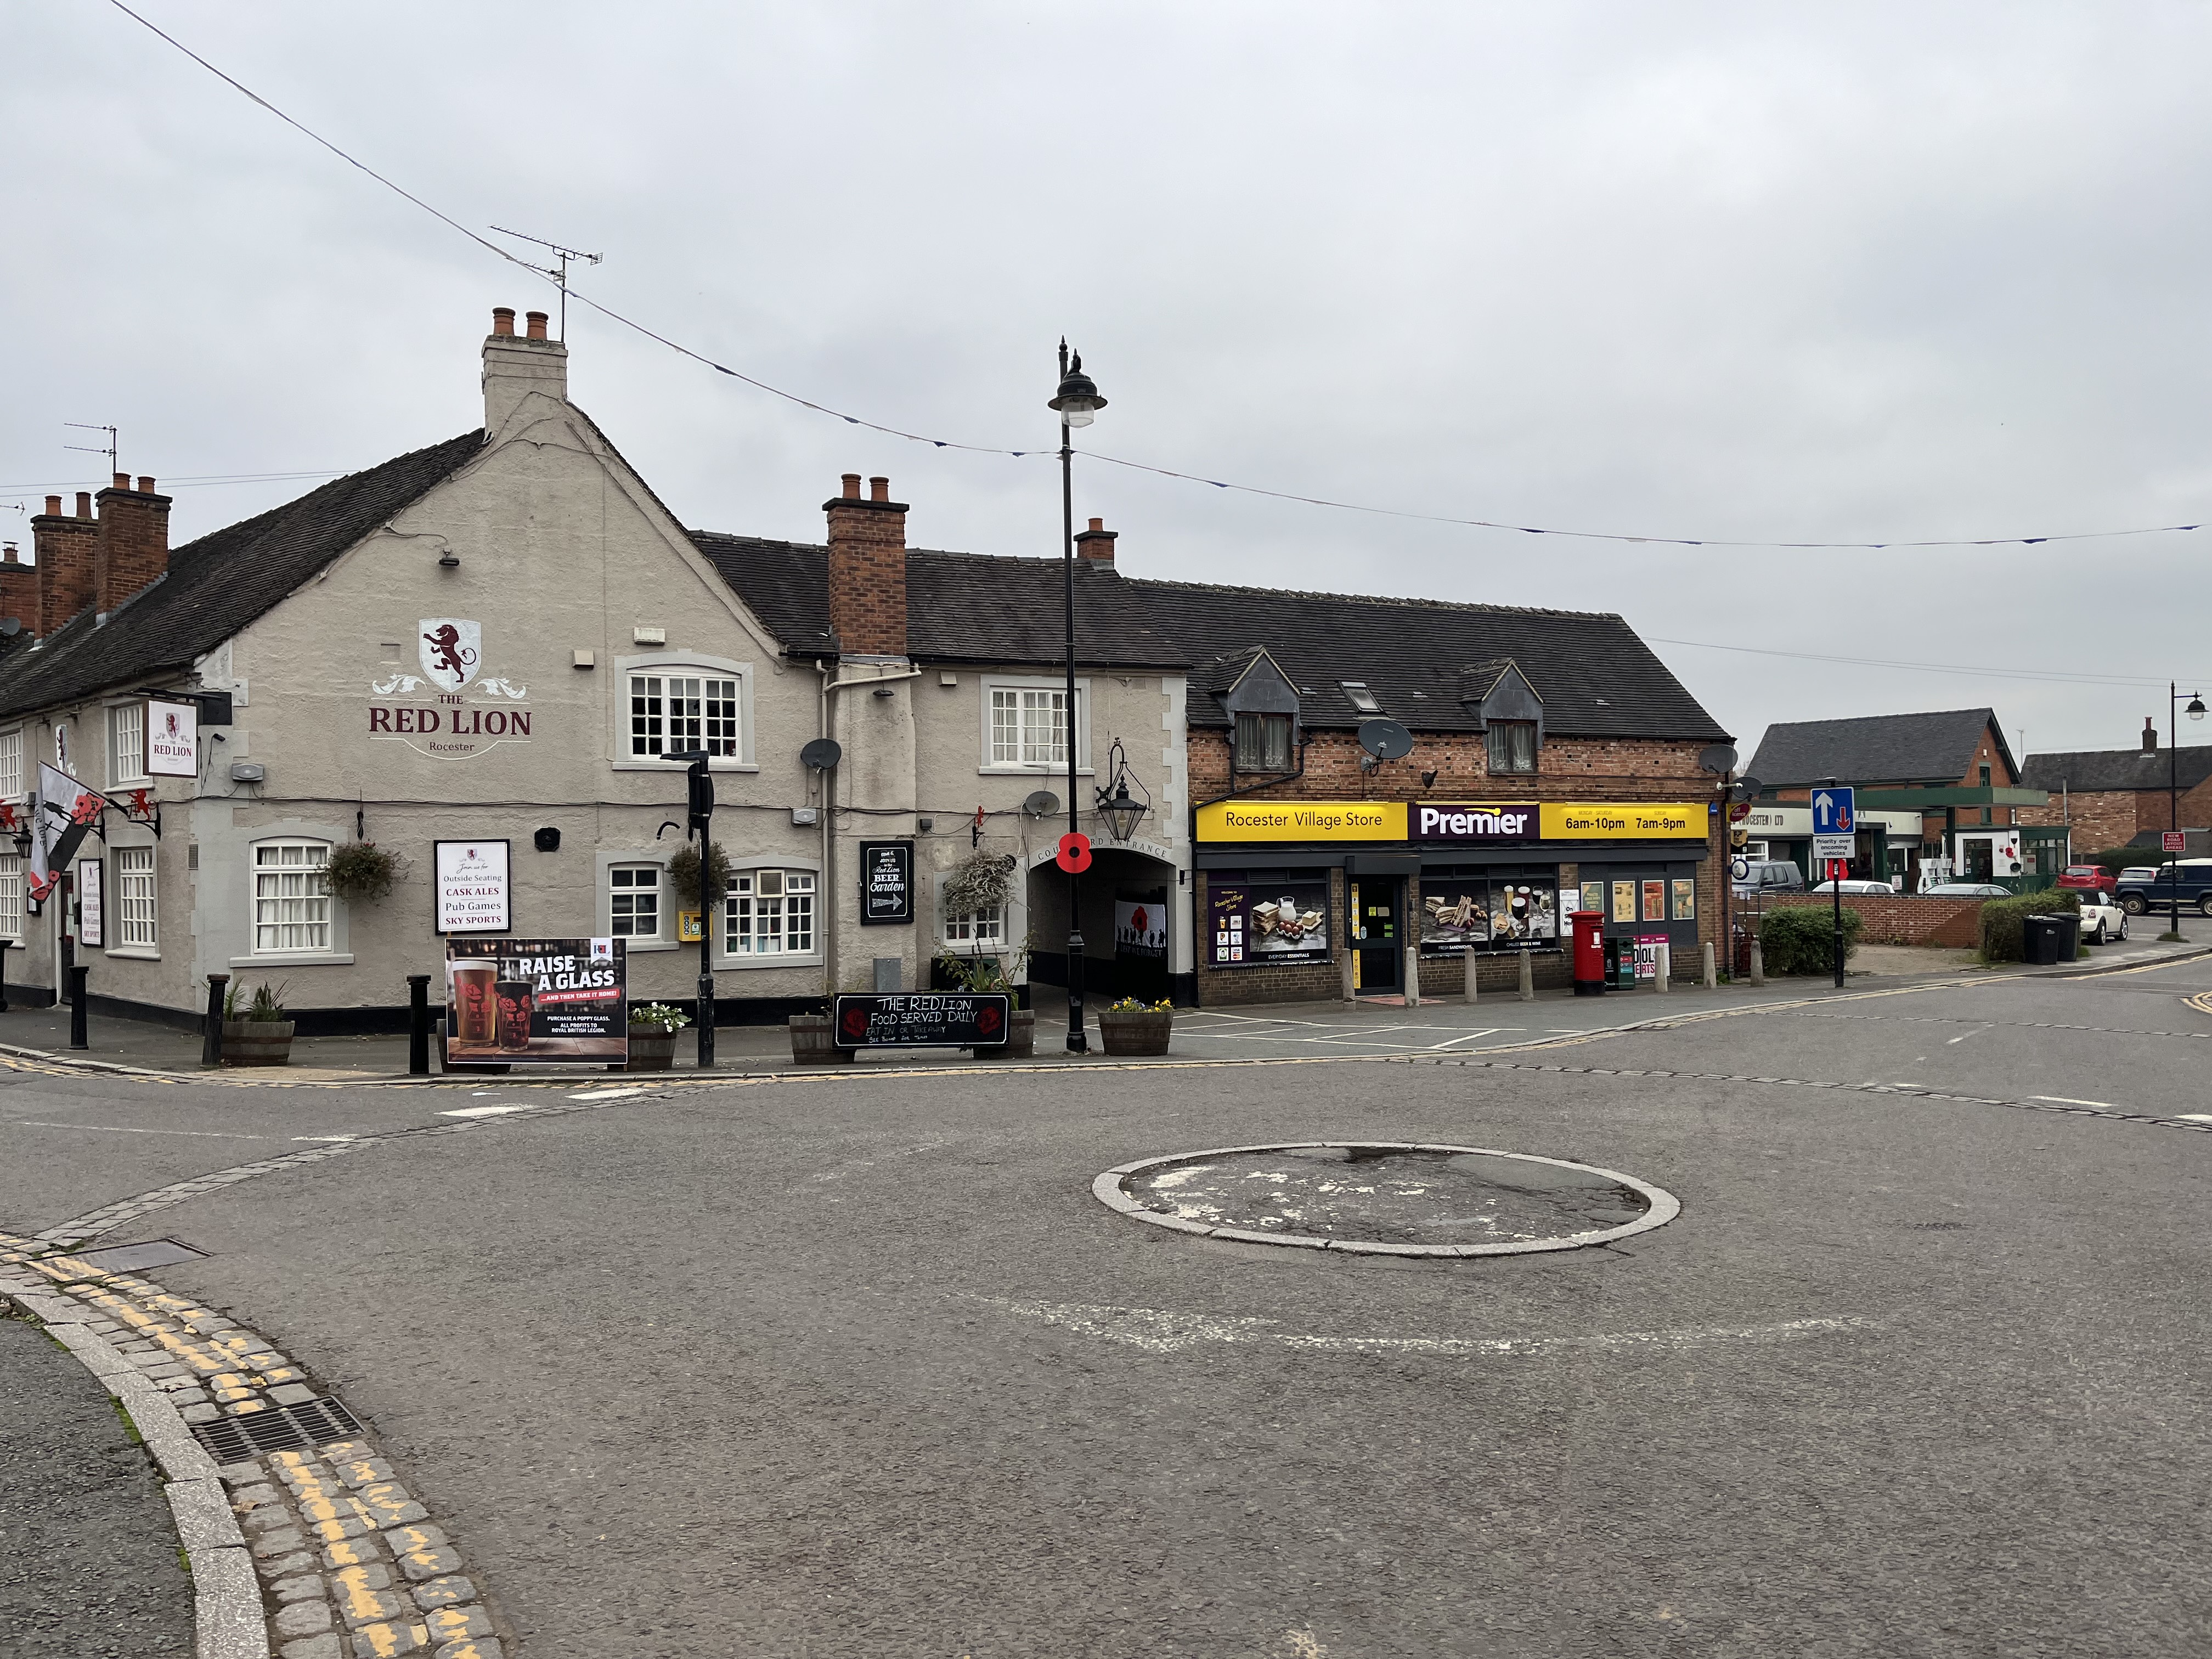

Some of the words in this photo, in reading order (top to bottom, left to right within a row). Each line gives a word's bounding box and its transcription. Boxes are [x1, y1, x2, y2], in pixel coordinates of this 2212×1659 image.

[438, 695, 464, 704] THE
[369, 708, 440, 733] RED
[451, 710, 532, 735] LION
[154, 744, 171, 755] RED
[173, 747, 191, 757] LION
[429, 742, 475, 751] Rocester
[1226, 812, 1288, 826] Rocester
[1295, 811, 1341, 830] Village
[1346, 812, 1382, 826] Store
[1420, 808, 1528, 834] Premier
[1566, 817, 1625, 831] 6am-10pm
[1636, 817, 1685, 831] 7am-9pm
[1775, 815, 1784, 826] LTD
[1110, 838, 1167, 857] ENTRANCE
[456, 864, 473, 874] Join
[870, 882, 905, 893] Garden
[445, 902, 465, 911] Pub
[468, 902, 501, 910] Games
[1141, 949, 1163, 957] FORGET
[519, 955, 575, 975] RAISE
[538, 974, 552, 991] A
[556, 970, 614, 990] GLASS
[877, 997, 905, 1011] THE
[871, 1013, 898, 1026] FOOD
[900, 1012, 942, 1023] SERVED
[947, 1011, 978, 1023] DAILY
[866, 1027, 881, 1036] EAT
[883, 1026, 895, 1035] IN
